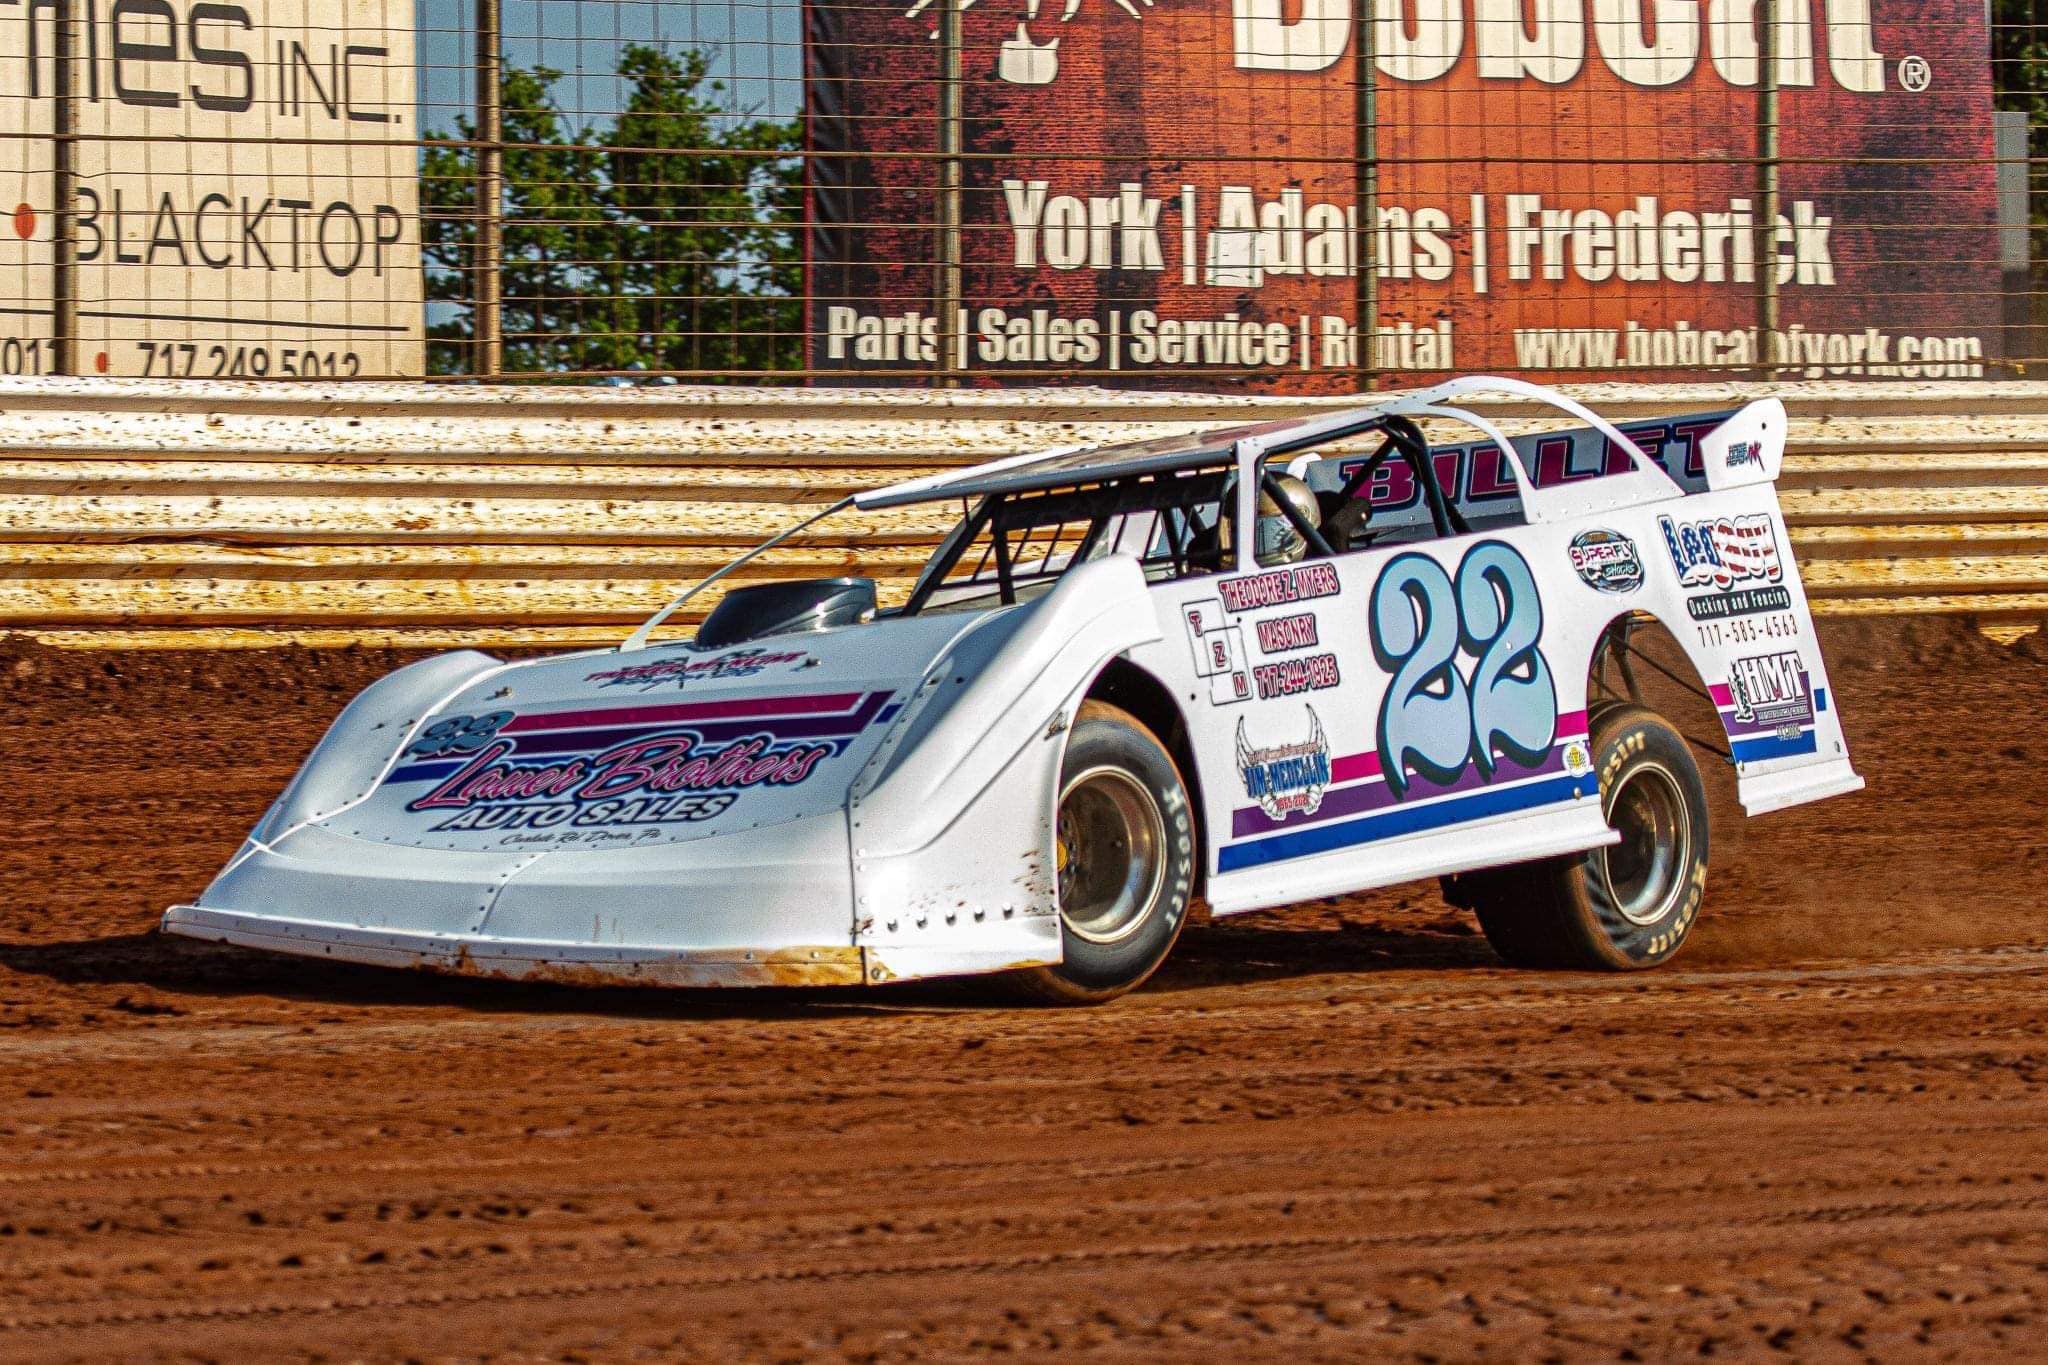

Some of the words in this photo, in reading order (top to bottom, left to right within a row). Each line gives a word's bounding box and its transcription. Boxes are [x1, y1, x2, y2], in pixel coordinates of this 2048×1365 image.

[276, 39, 402, 124] INC.
[76, 187, 401, 277] BLACKTOP
[1002, 180, 1165, 271] York
[1207, 185, 1454, 282] Adams
[137, 341, 198, 377] 717
[208, 345, 272, 377] 249
[827, 306, 938, 362] Parts
[978, 308, 1100, 363] Sales
[1130, 310, 1290, 366] Service
[1341, 420, 1724, 512] BILLET
[1569, 540, 1635, 568] SUPERFLY
[1219, 572, 1285, 613] THEODORE
[1294, 562, 1340, 600] MYERS
[1688, 594, 1730, 616] Decking
[1731, 592, 1748, 610] and
[1750, 586, 1790, 608] Fencing
[1257, 613, 1318, 654] MASONRY
[1368, 539, 1558, 802] 22
[400, 711, 516, 758] 22
[578, 734, 828, 800] Brothers
[428, 802, 581, 832] AUTO
[571, 793, 739, 826] SALES
